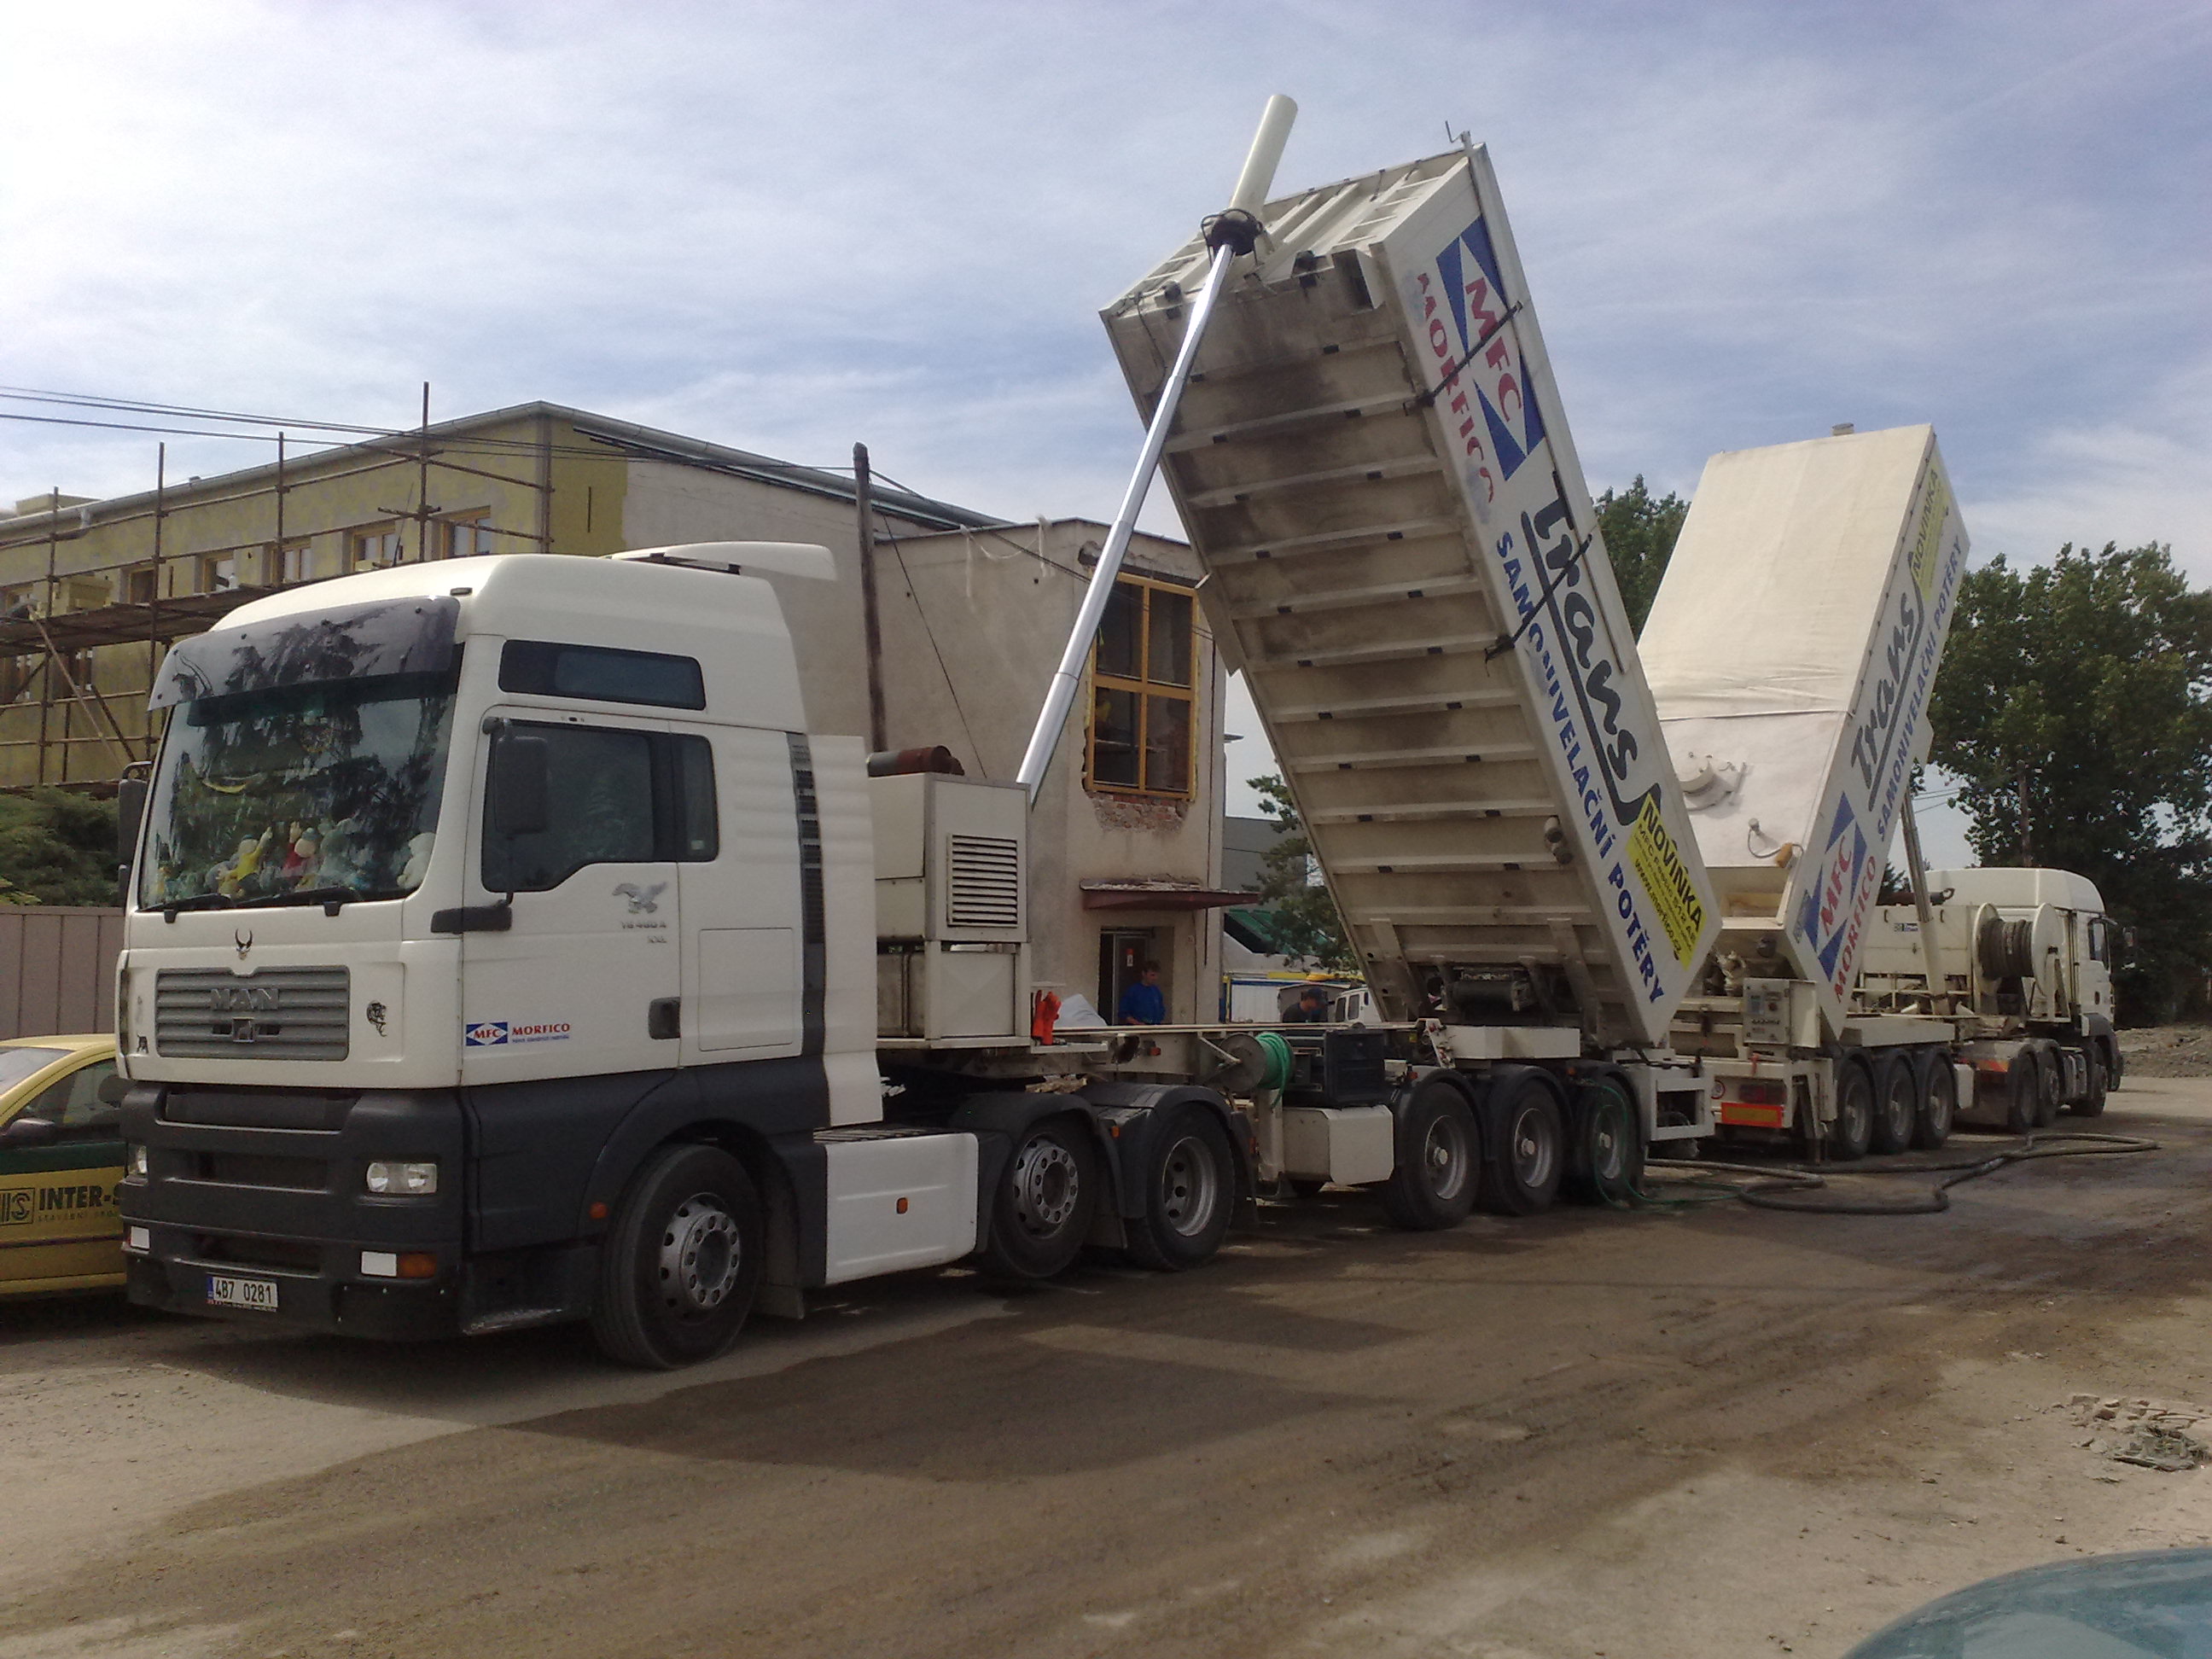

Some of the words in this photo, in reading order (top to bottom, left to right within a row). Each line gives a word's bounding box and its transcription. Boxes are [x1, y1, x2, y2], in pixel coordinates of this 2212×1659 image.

[1465, 277, 1522, 422] MFC
[1912, 469, 1937, 577] NOVINKA
[1851, 592, 1914, 789] Trans
[1877, 624, 1936, 842] SAMONIVELAČNÍ
[1934, 535, 1961, 630] POTĚRY
[1643, 805, 1701, 932] NOVINKA
[1820, 835, 1852, 937] MFC
[1608, 862, 1664, 1003] POTĚRY
[1834, 856, 1876, 1004] MORFICO
[211, 989, 278, 1010] MAN
[474, 1029, 500, 1039] MFC
[512, 1023, 570, 1035] MORFICO
[216, 1280, 235, 1299] 4B7
[243, 1283, 272, 1304] 0281
